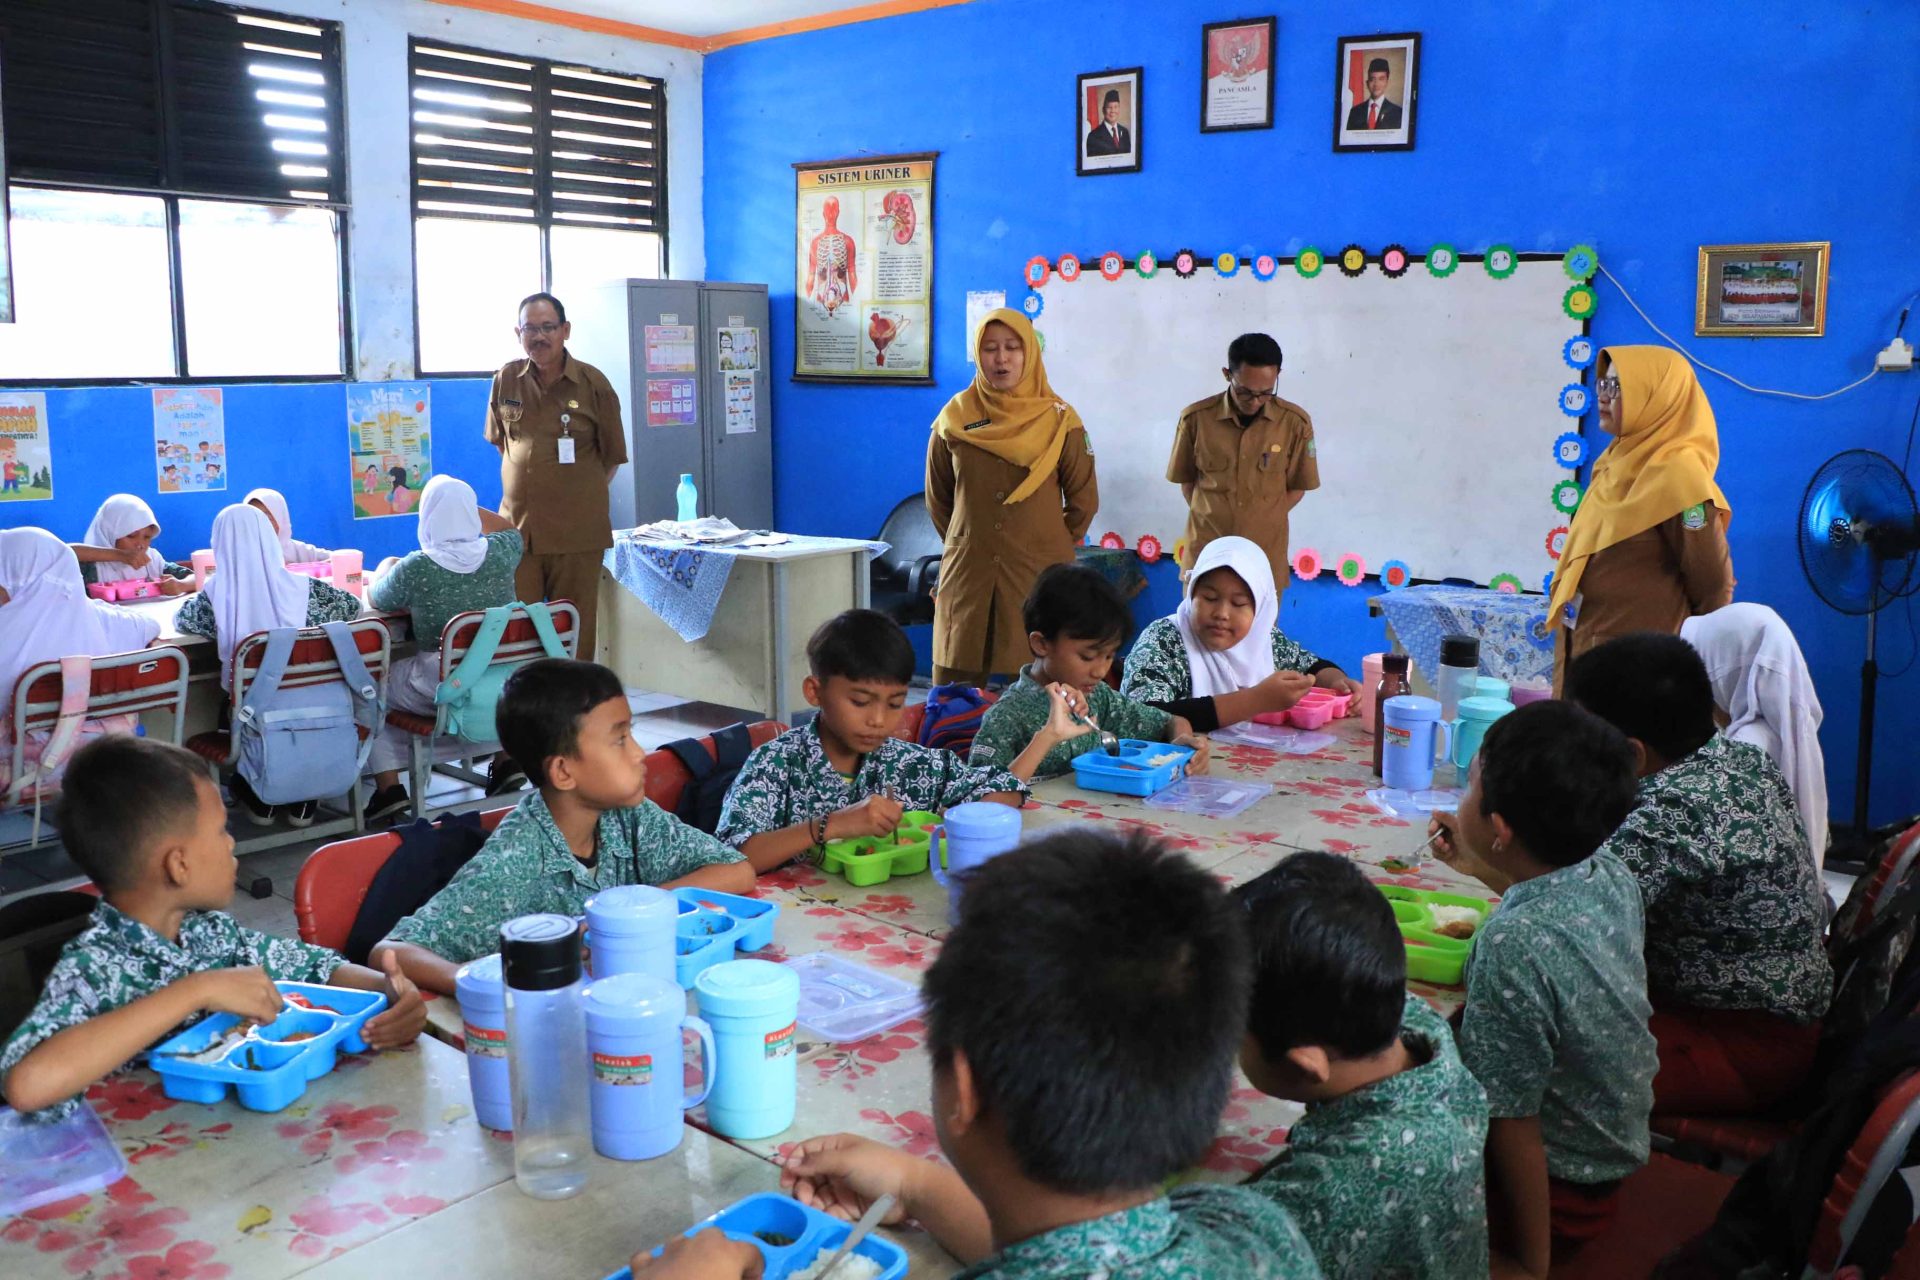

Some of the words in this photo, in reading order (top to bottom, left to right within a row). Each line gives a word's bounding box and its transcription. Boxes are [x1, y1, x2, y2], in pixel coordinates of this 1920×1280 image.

[1219, 86, 1256, 94] PANCASILA
[817, 170, 860, 184] SISTEM
[864, 167, 911, 181] URINER
[371, 387, 404, 404] Mari
[1145, 542, 1153, 554] 3
